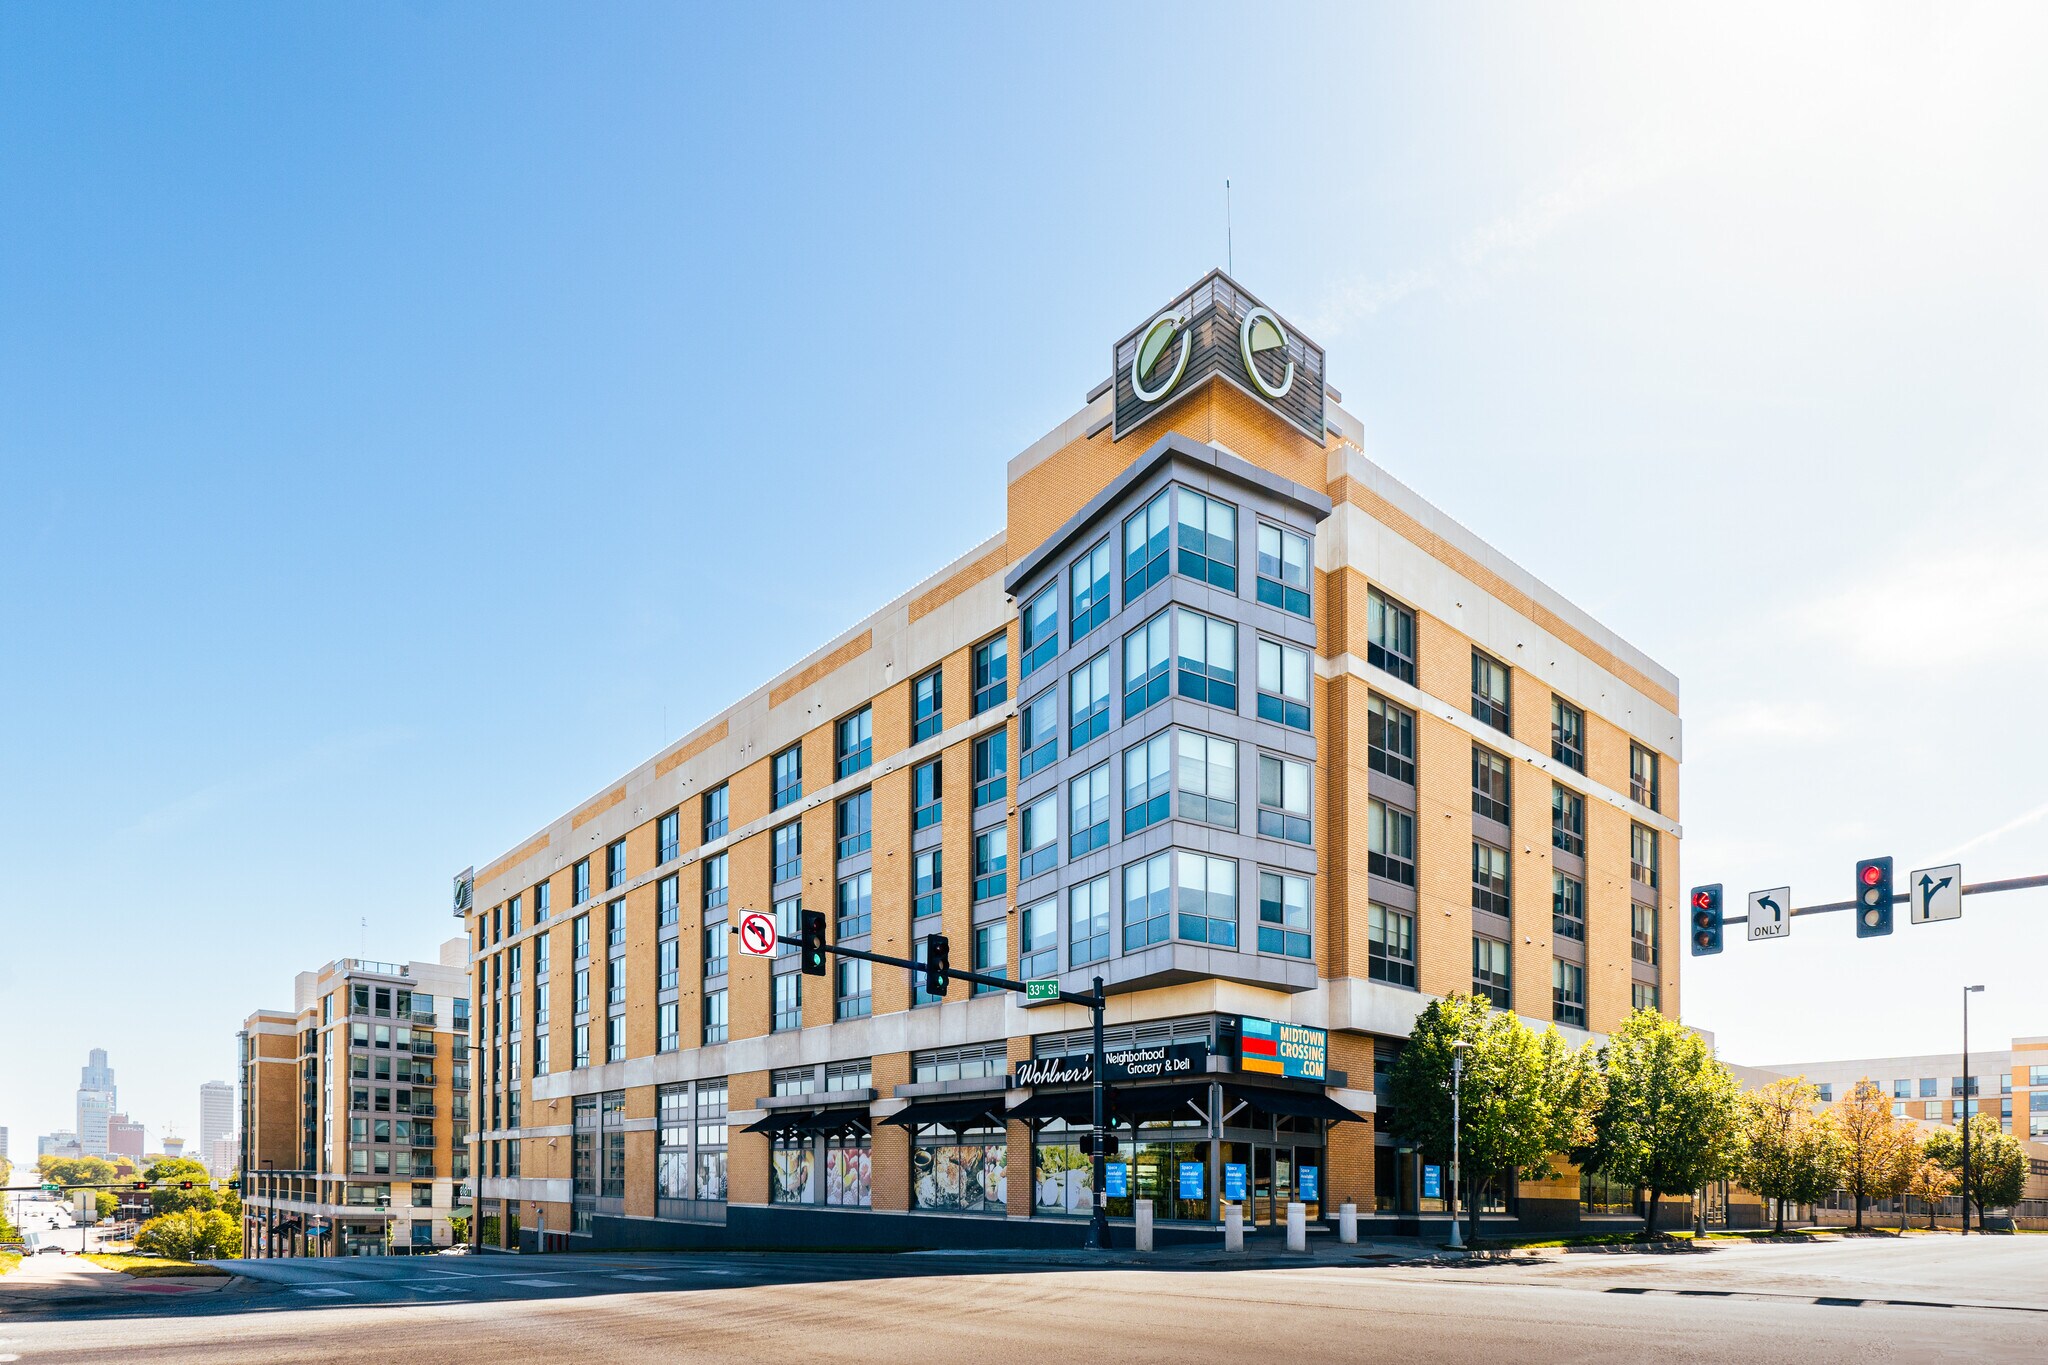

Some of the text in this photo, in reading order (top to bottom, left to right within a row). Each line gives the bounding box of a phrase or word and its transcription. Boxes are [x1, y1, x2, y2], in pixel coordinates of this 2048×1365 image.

[1754, 924, 1782, 937] ONLY
[1029, 983, 1057, 996] 33rd St
[1280, 1026, 1324, 1046] MIDTOWN
[1105, 1047, 1165, 1066] Neighborhood
[1280, 1042, 1324, 1061] CROSSING
[1017, 1054, 1093, 1086] Wohlner's
[1127, 1057, 1190, 1075] Grocery & Deli
[1300, 1061, 1324, 1077] .COM
